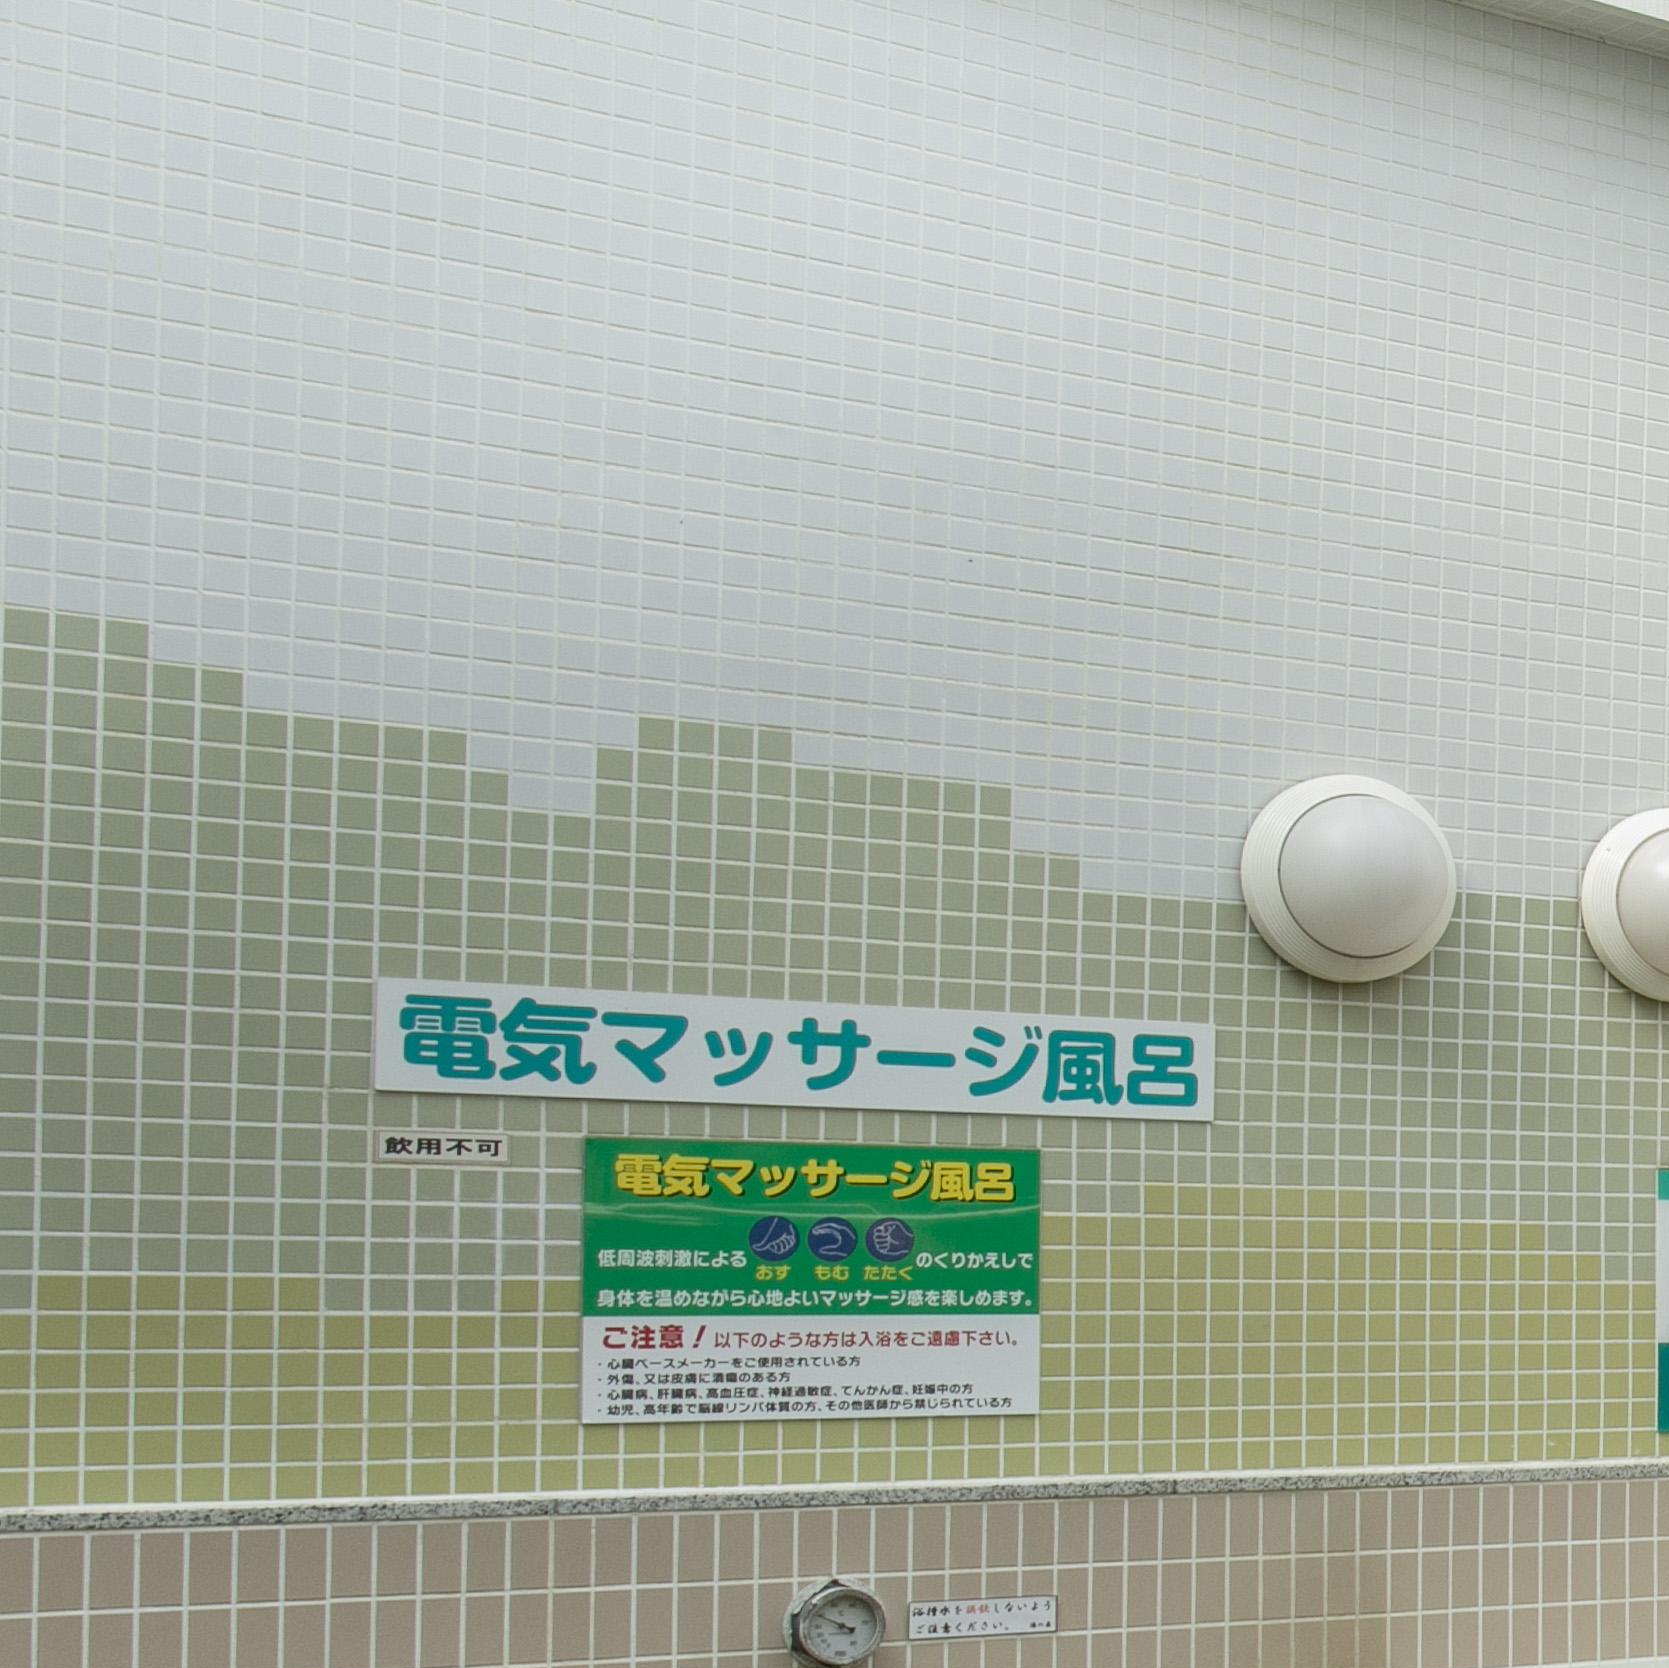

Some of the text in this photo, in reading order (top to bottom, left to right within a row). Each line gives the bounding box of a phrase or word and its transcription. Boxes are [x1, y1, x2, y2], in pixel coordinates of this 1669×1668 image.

[399, 994, 1199, 1107] 電気マッサージ風呂
[384, 1136, 503, 1156] 飲用不可
[614, 1153, 1017, 1203] 電気マッサージ風呂
[598, 1249, 1033, 1281] 低周波刺激による おす もむ たたく のくりかえしで
[597, 1289, 1032, 1307] 身体を温めながら心地よいマッサージ感を楽しめます。
[602, 1324, 1018, 1350] ご注意！ 以下のような方は入浴をご遠慮下さい。
